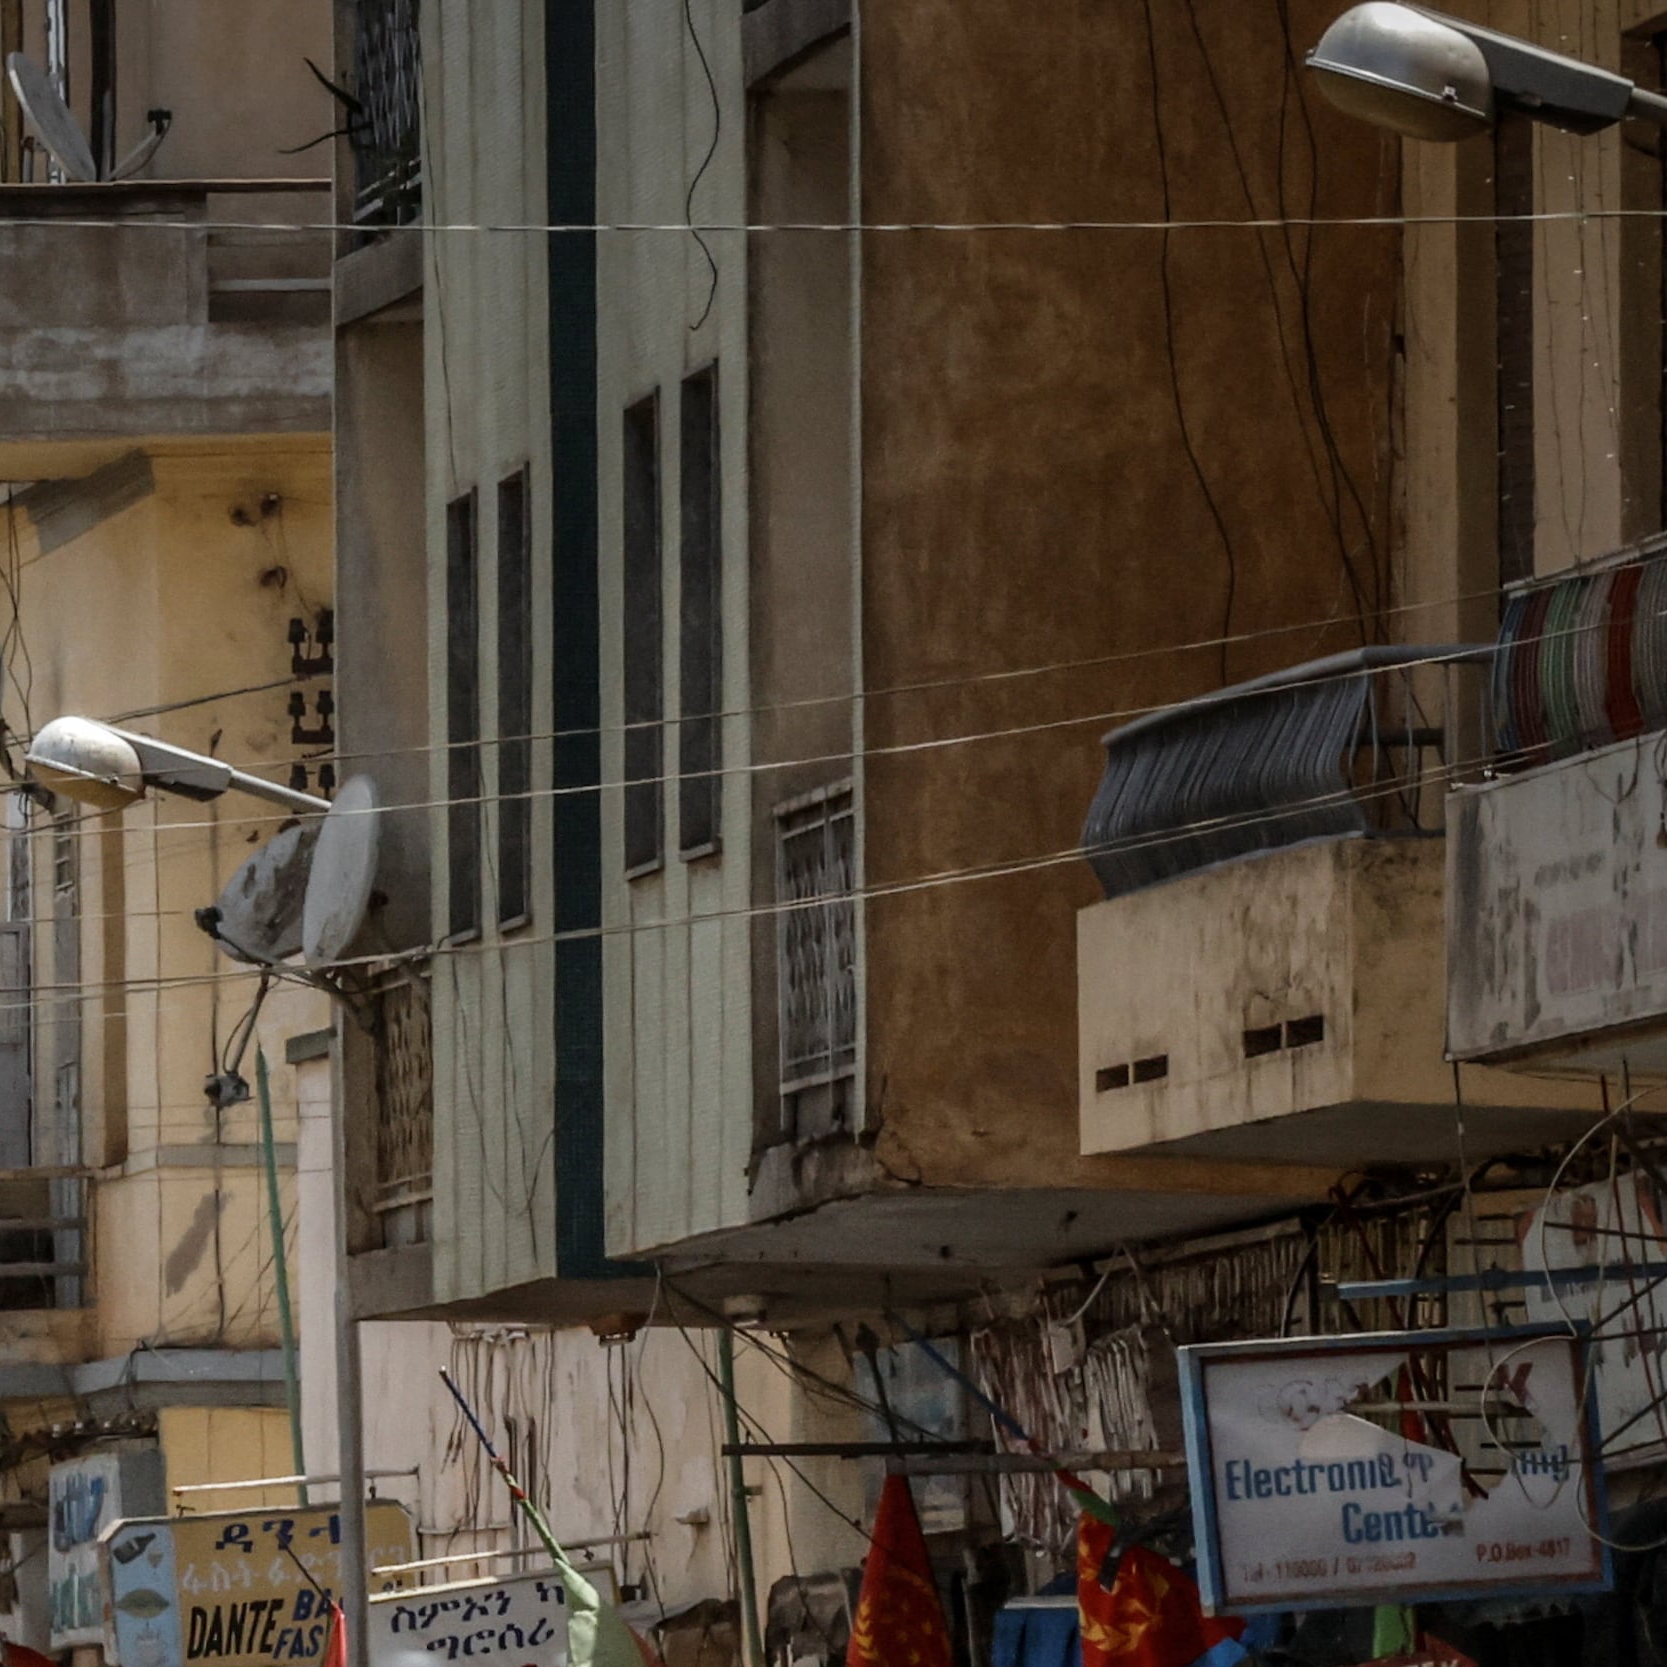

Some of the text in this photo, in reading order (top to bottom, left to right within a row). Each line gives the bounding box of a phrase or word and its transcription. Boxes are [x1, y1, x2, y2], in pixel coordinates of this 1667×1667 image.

[291, 1588, 344, 1622] BA
[186, 1599, 285, 1660] DANTE
[272, 1625, 324, 1660] FAS
